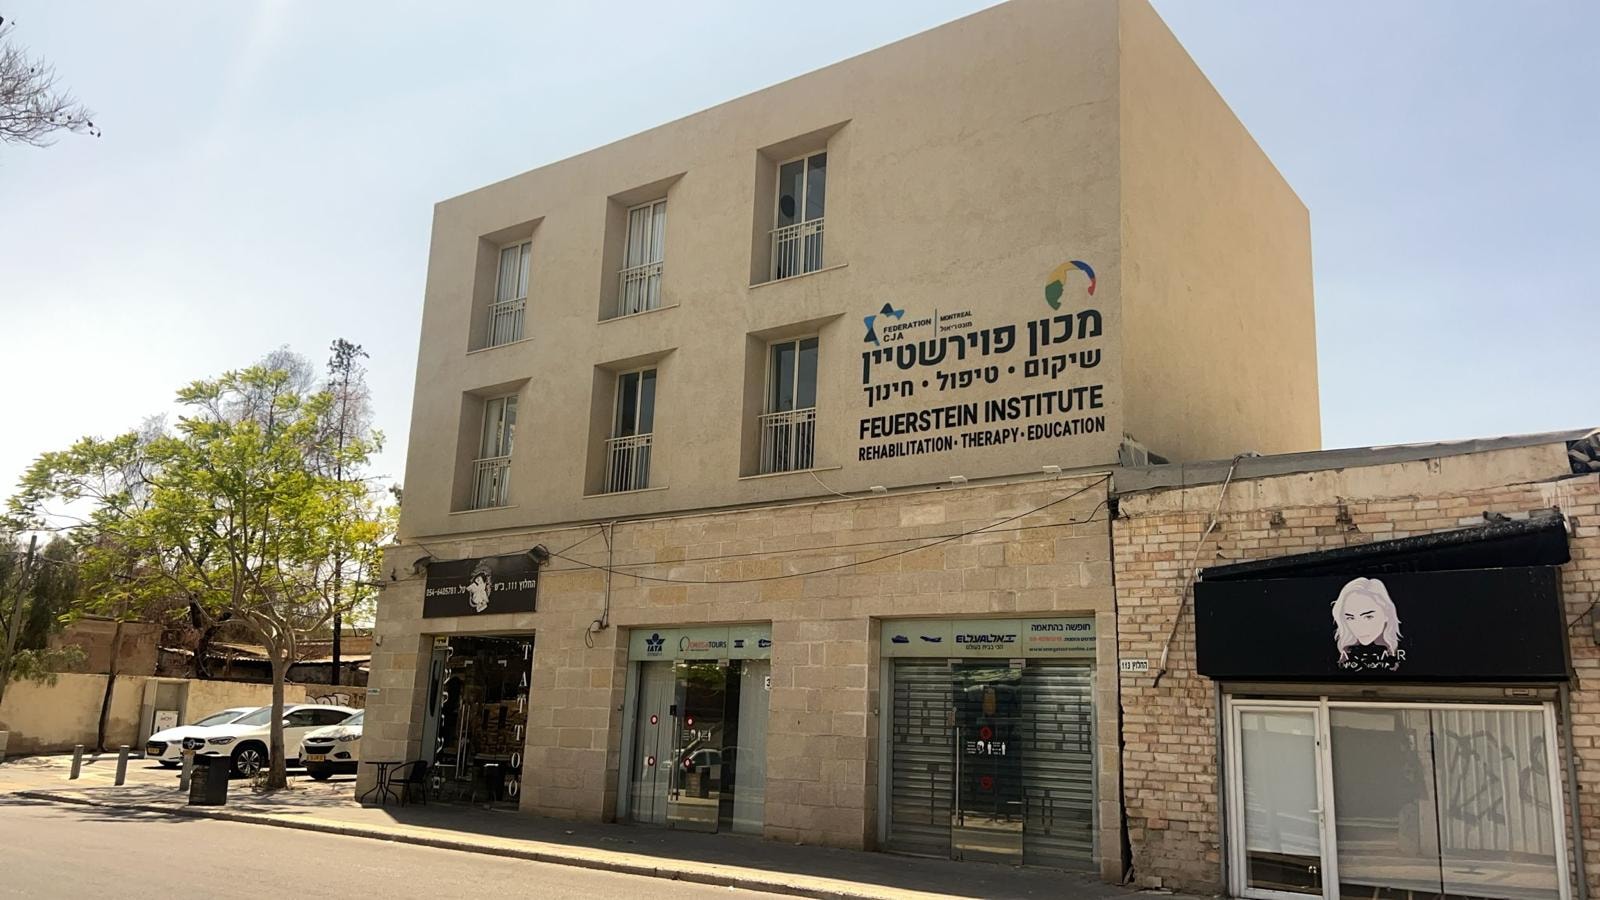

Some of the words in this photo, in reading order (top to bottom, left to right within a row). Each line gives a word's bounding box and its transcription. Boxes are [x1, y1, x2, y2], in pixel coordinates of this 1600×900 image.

[883, 318, 932, 333] FEDERATION
[940, 310, 973, 321] MONTREAL
[883, 332, 904, 343] CJA
[1027, 309, 1103, 357] מכון
[862, 325, 1016, 384] פוירשטיין
[1024, 349, 1102, 379] שיקום
[937, 366, 999, 391] טיפול
[863, 380, 914, 408] חינוך
[859, 402, 978, 439] FEUERSTEIN
[984, 384, 1104, 423] INSTITUTE
[858, 435, 952, 461] REHABILITATION
[961, 427, 1019, 449] THERAPY
[1027, 415, 1105, 441] EDUCATION
[1031, 623, 1064, 631] בהתאמה
[1065, 623, 1091, 631] חופשה
[1121, 661, 1131, 670] 113
[508, 644, 531, 796] TATTOO
